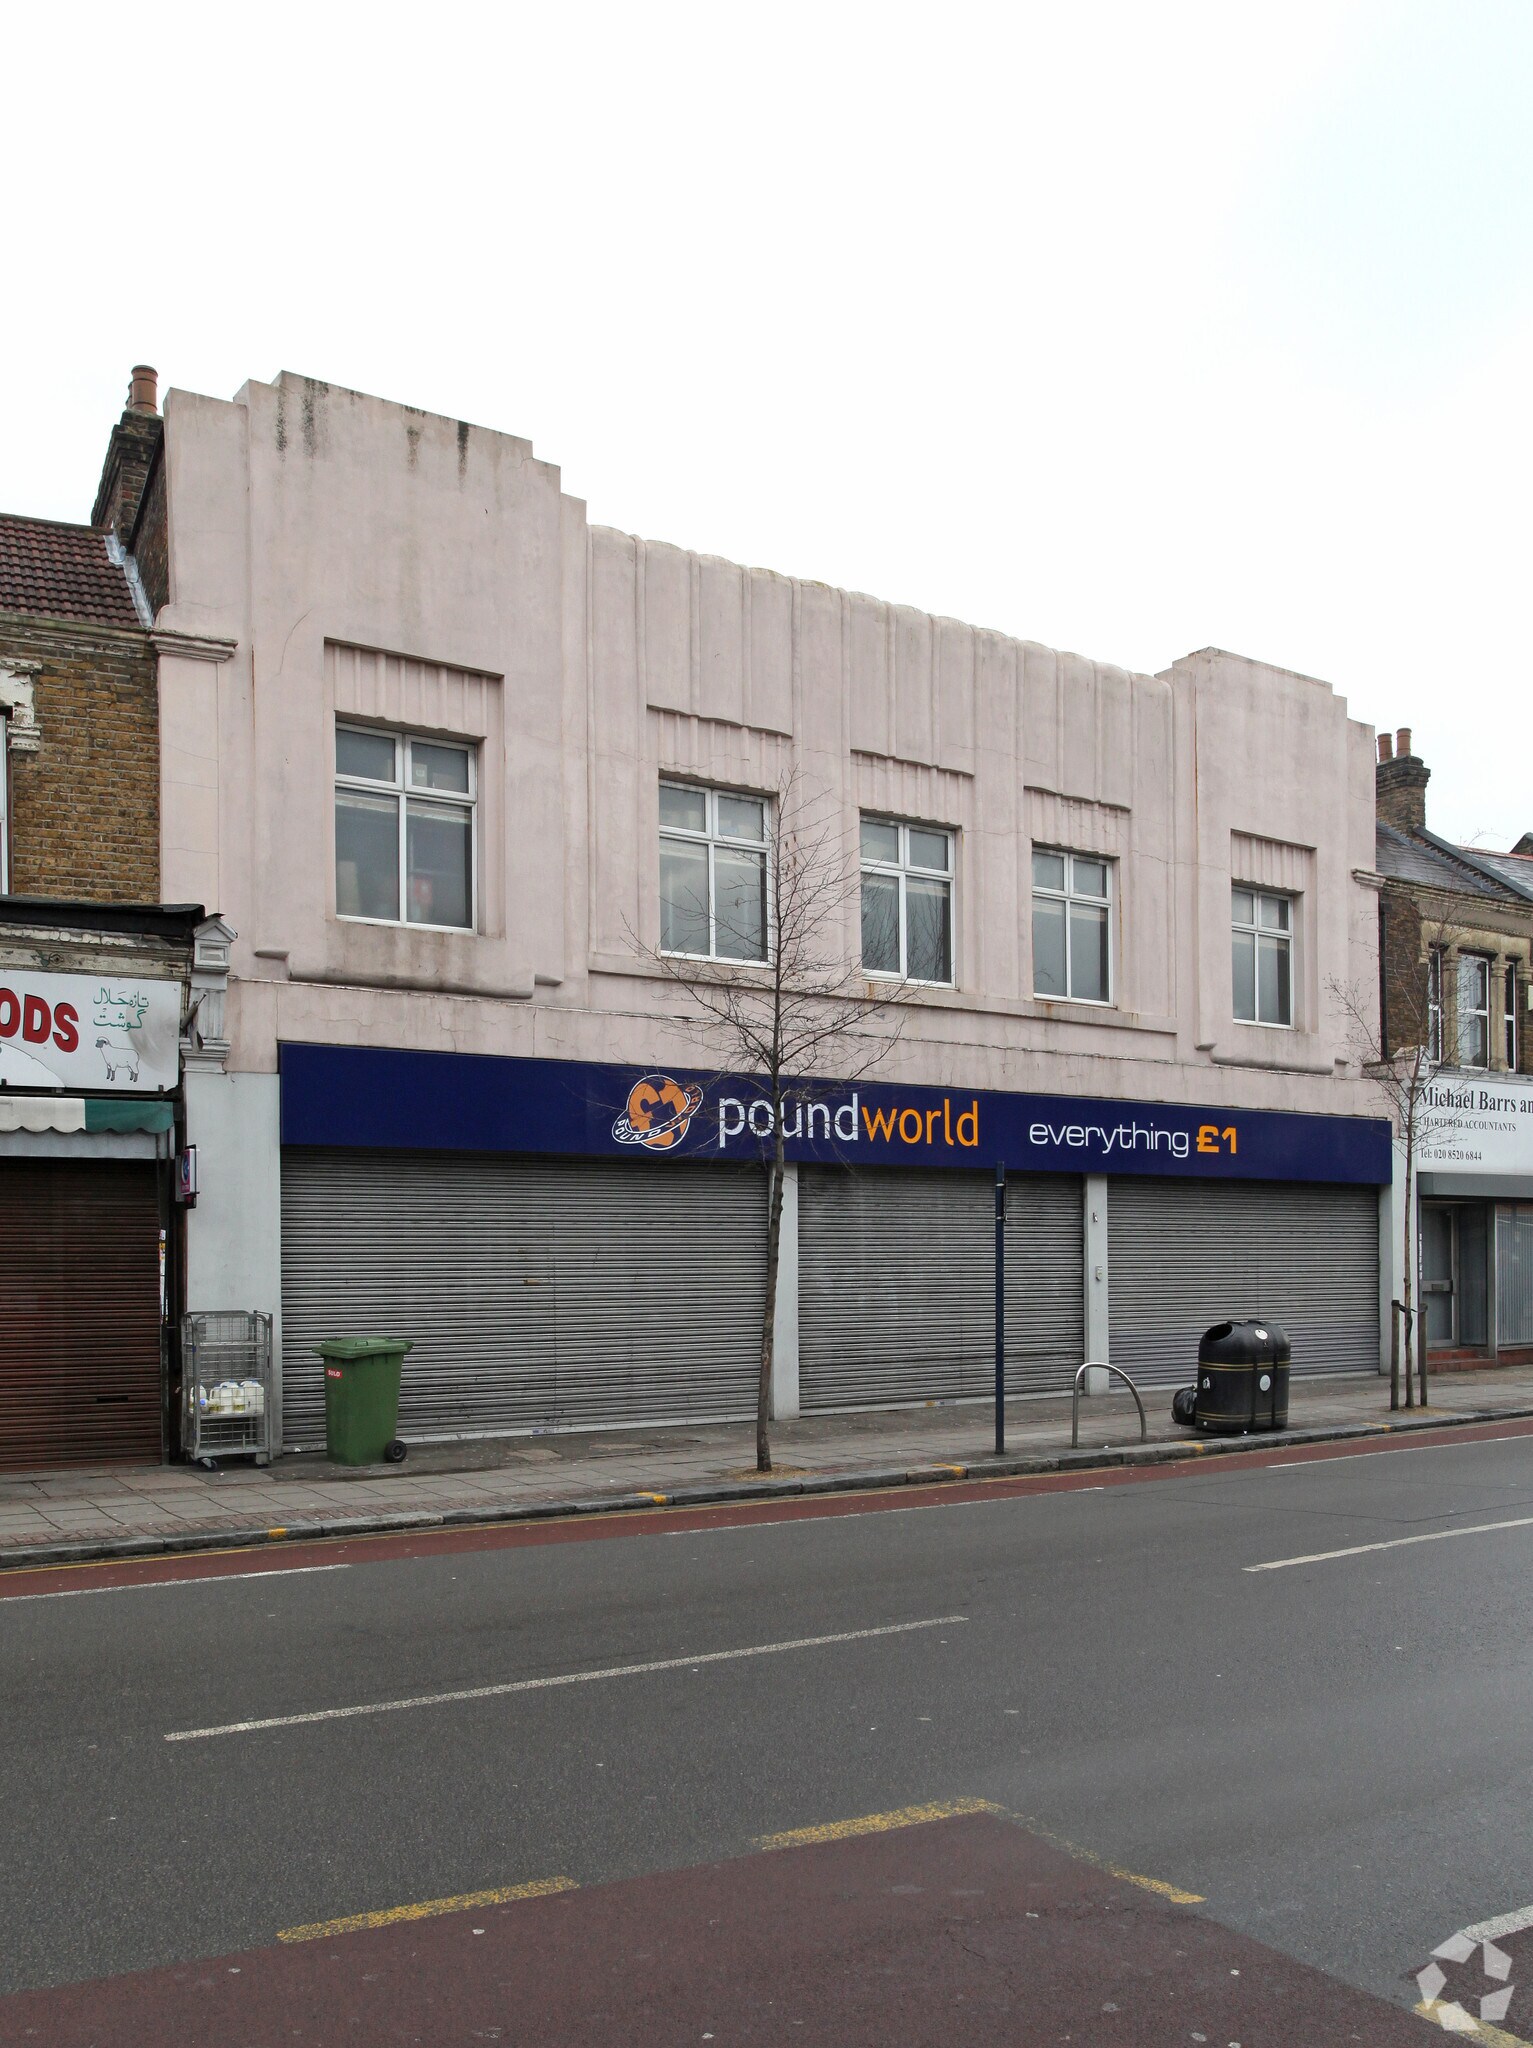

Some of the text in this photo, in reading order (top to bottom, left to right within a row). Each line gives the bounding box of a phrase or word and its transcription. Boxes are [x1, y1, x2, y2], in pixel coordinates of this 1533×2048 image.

[1420, 1087, 1475, 1110] Michael
[1479, 1090, 1517, 1113] Barrs
[615, 1118, 662, 1141] POUND
[1463, 1119, 1517, 1132] ACCOUNTANTS
[1029, 1121, 1237, 1158] everything £1
[1420, 1148, 1482, 1161] Tel: 020 8520 6844
